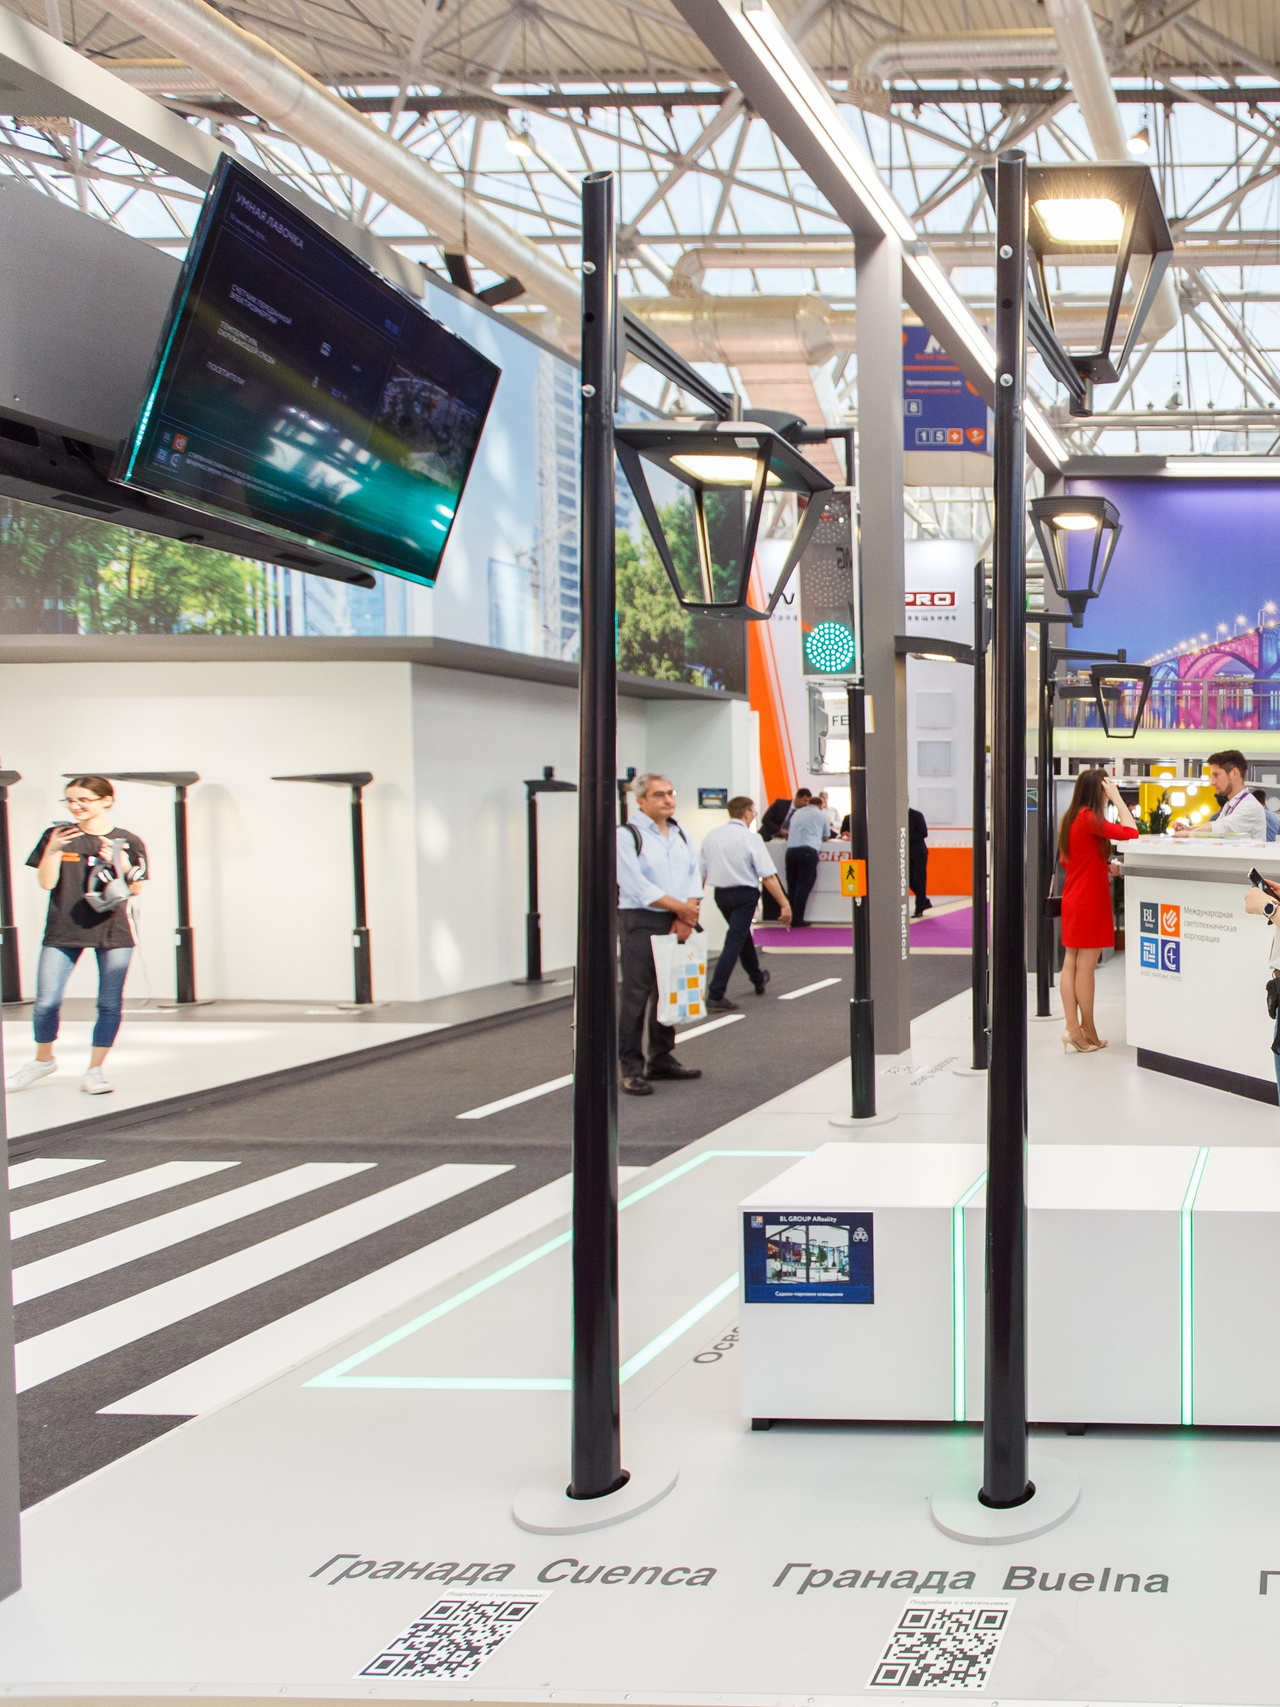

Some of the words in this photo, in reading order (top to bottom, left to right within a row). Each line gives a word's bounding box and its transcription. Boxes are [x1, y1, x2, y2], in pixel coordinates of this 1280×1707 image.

[236, 192, 267, 221] УМНАЯ
[266, 216, 304, 249] ЛАВОЧКА
[909, 401, 918, 412] 8
[935, 431, 944, 441] 5
[1143, 908, 1155, 922] BL
[1184, 906, 1233, 919] Международная
[1184, 921, 1237, 932] светотехническая
[1184, 933, 1220, 943] корпорация
[308, 1553, 516, 1586] Гранада
[537, 1557, 718, 1587] Cuenca
[772, 1562, 977, 1595] Гранада
[1002, 1565, 1170, 1593] Buelna
